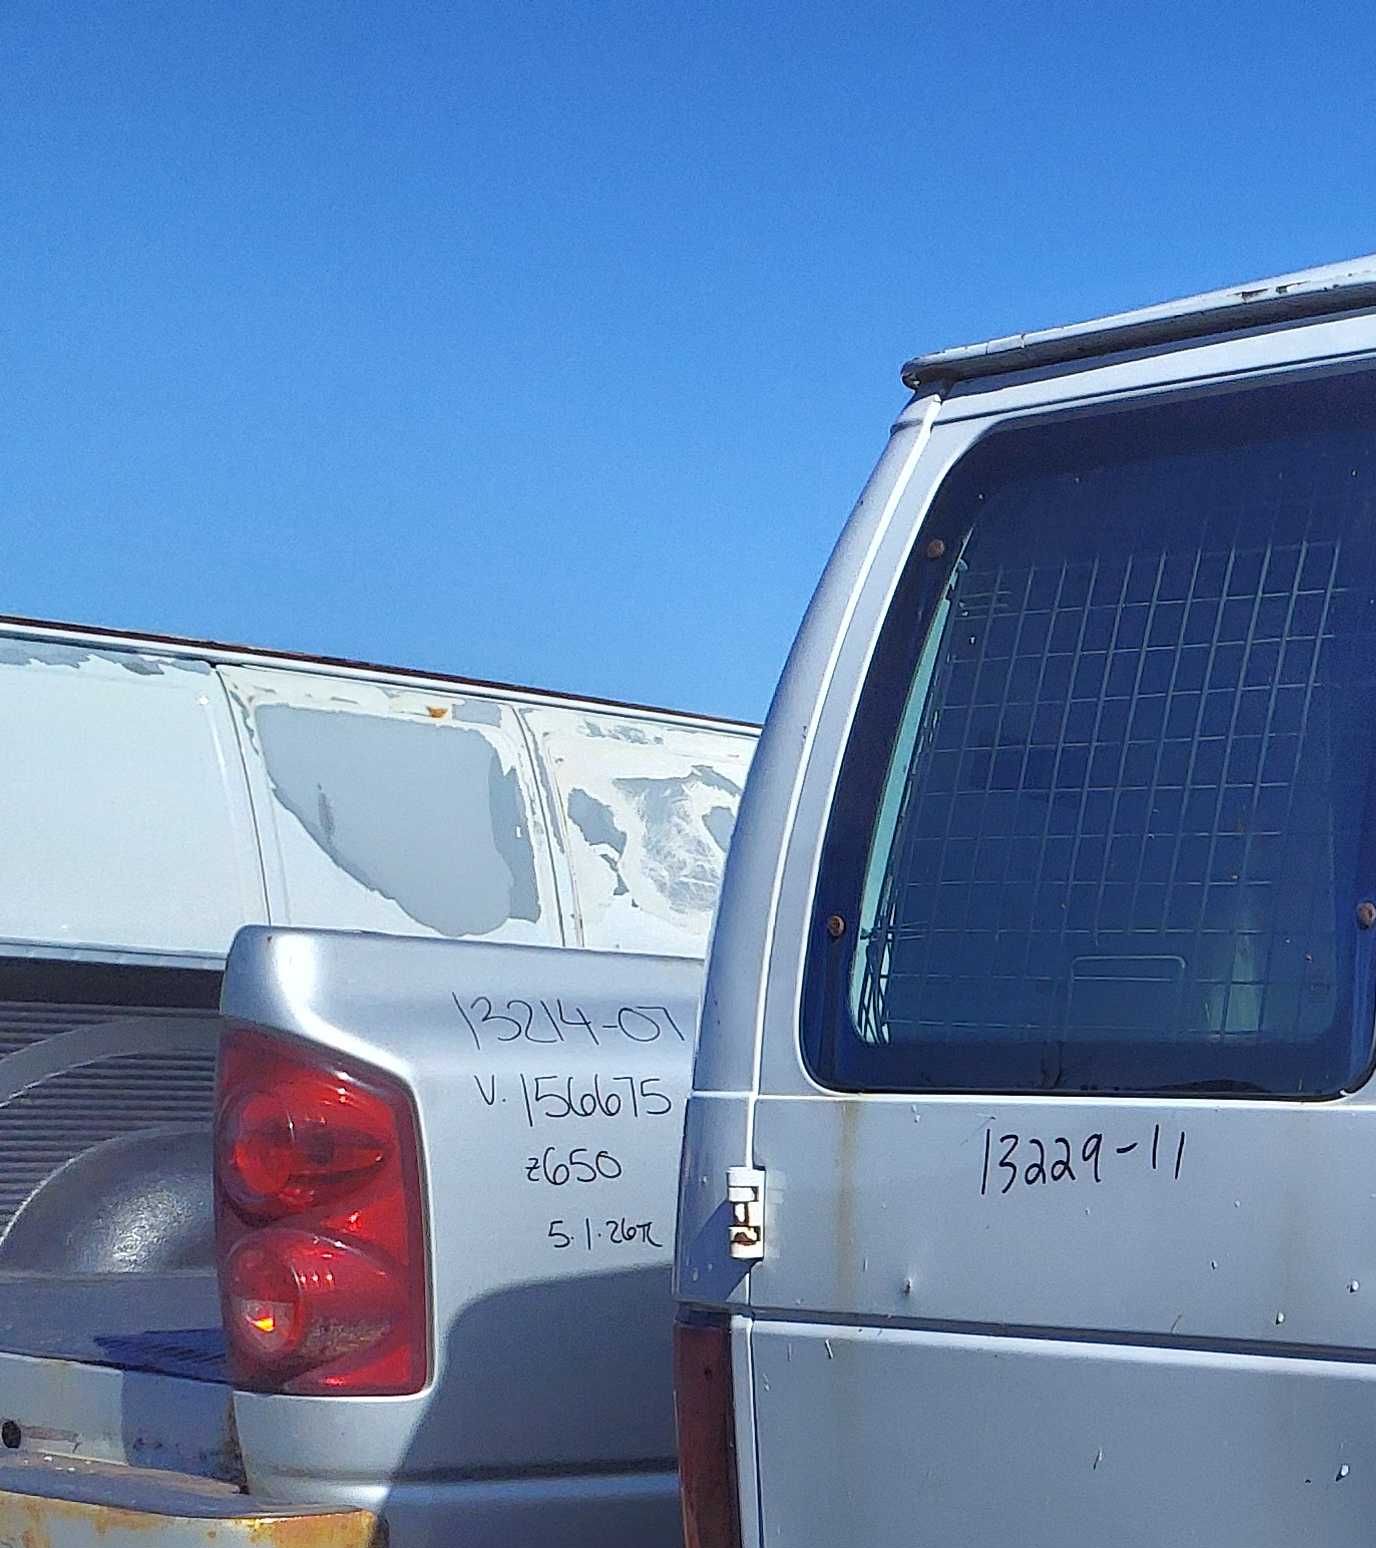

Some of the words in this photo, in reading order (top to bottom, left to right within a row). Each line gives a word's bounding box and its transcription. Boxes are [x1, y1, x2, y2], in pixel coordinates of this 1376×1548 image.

[452, 992, 686, 1050] 13214-07
[520, 1073, 672, 1128] 156675
[981, 1124, 1186, 1196] 13229-11
